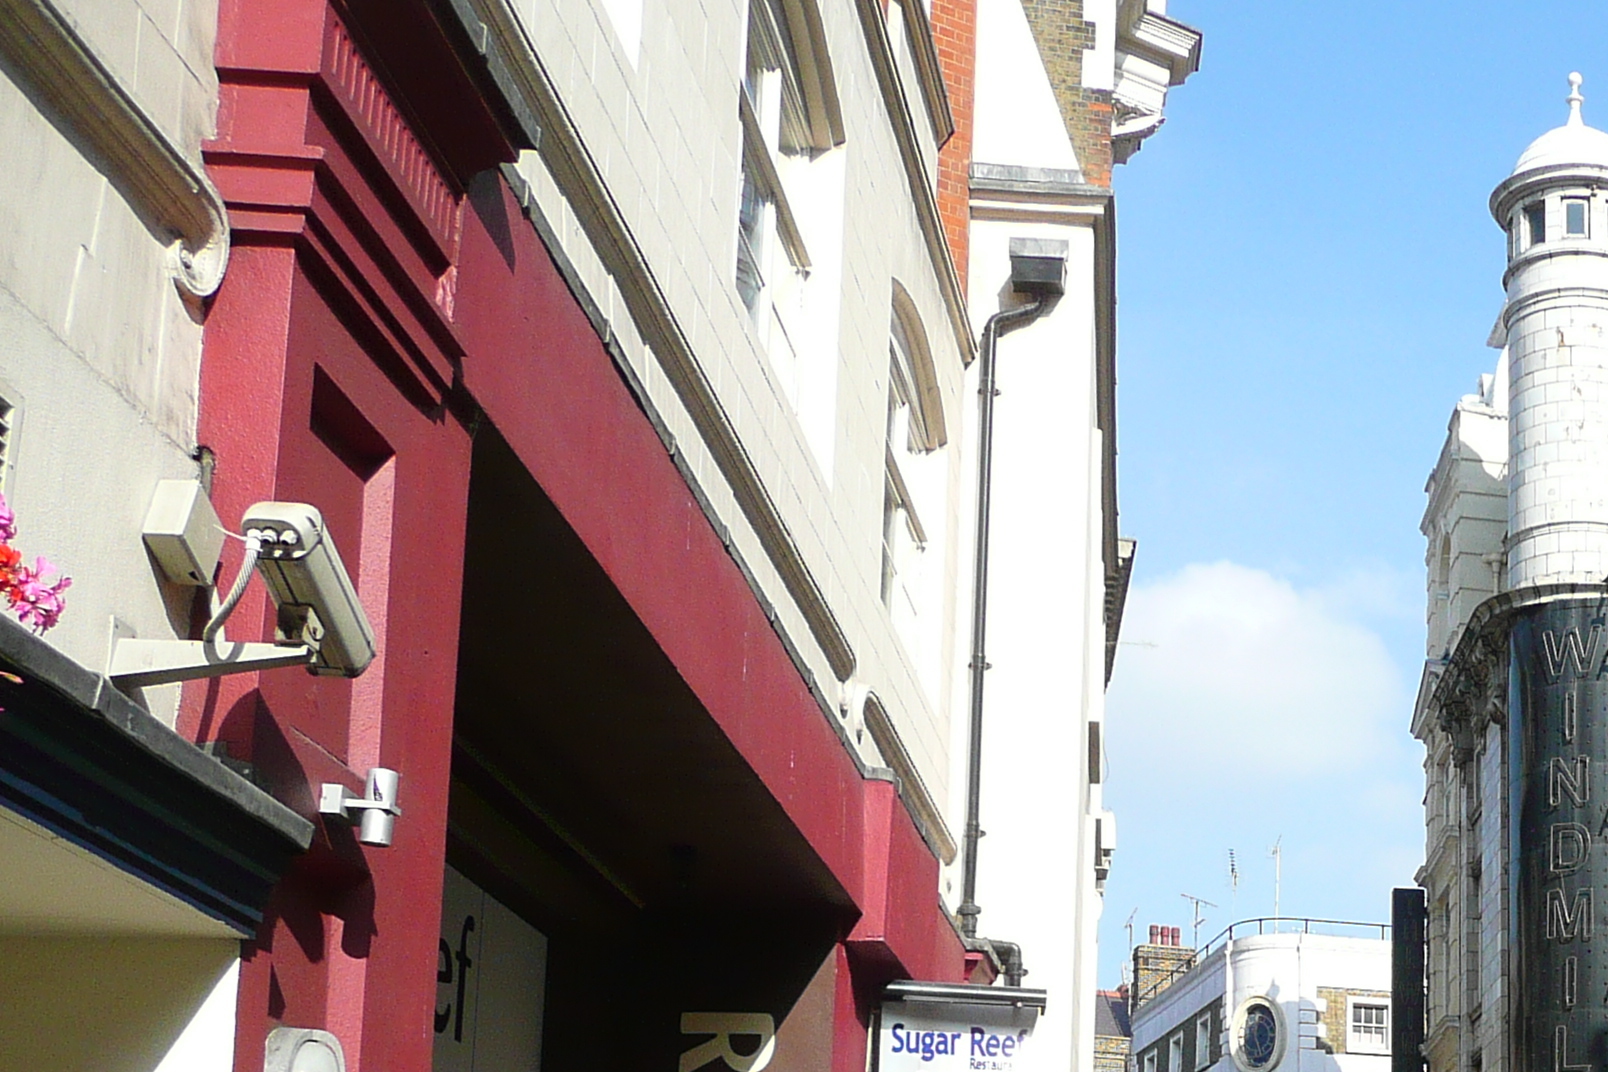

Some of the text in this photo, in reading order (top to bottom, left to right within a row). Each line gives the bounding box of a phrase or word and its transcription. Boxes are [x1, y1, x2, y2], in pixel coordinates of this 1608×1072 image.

[434, 914, 475, 1043] ef
[891, 1023, 1029, 1062] Sugar Reef
